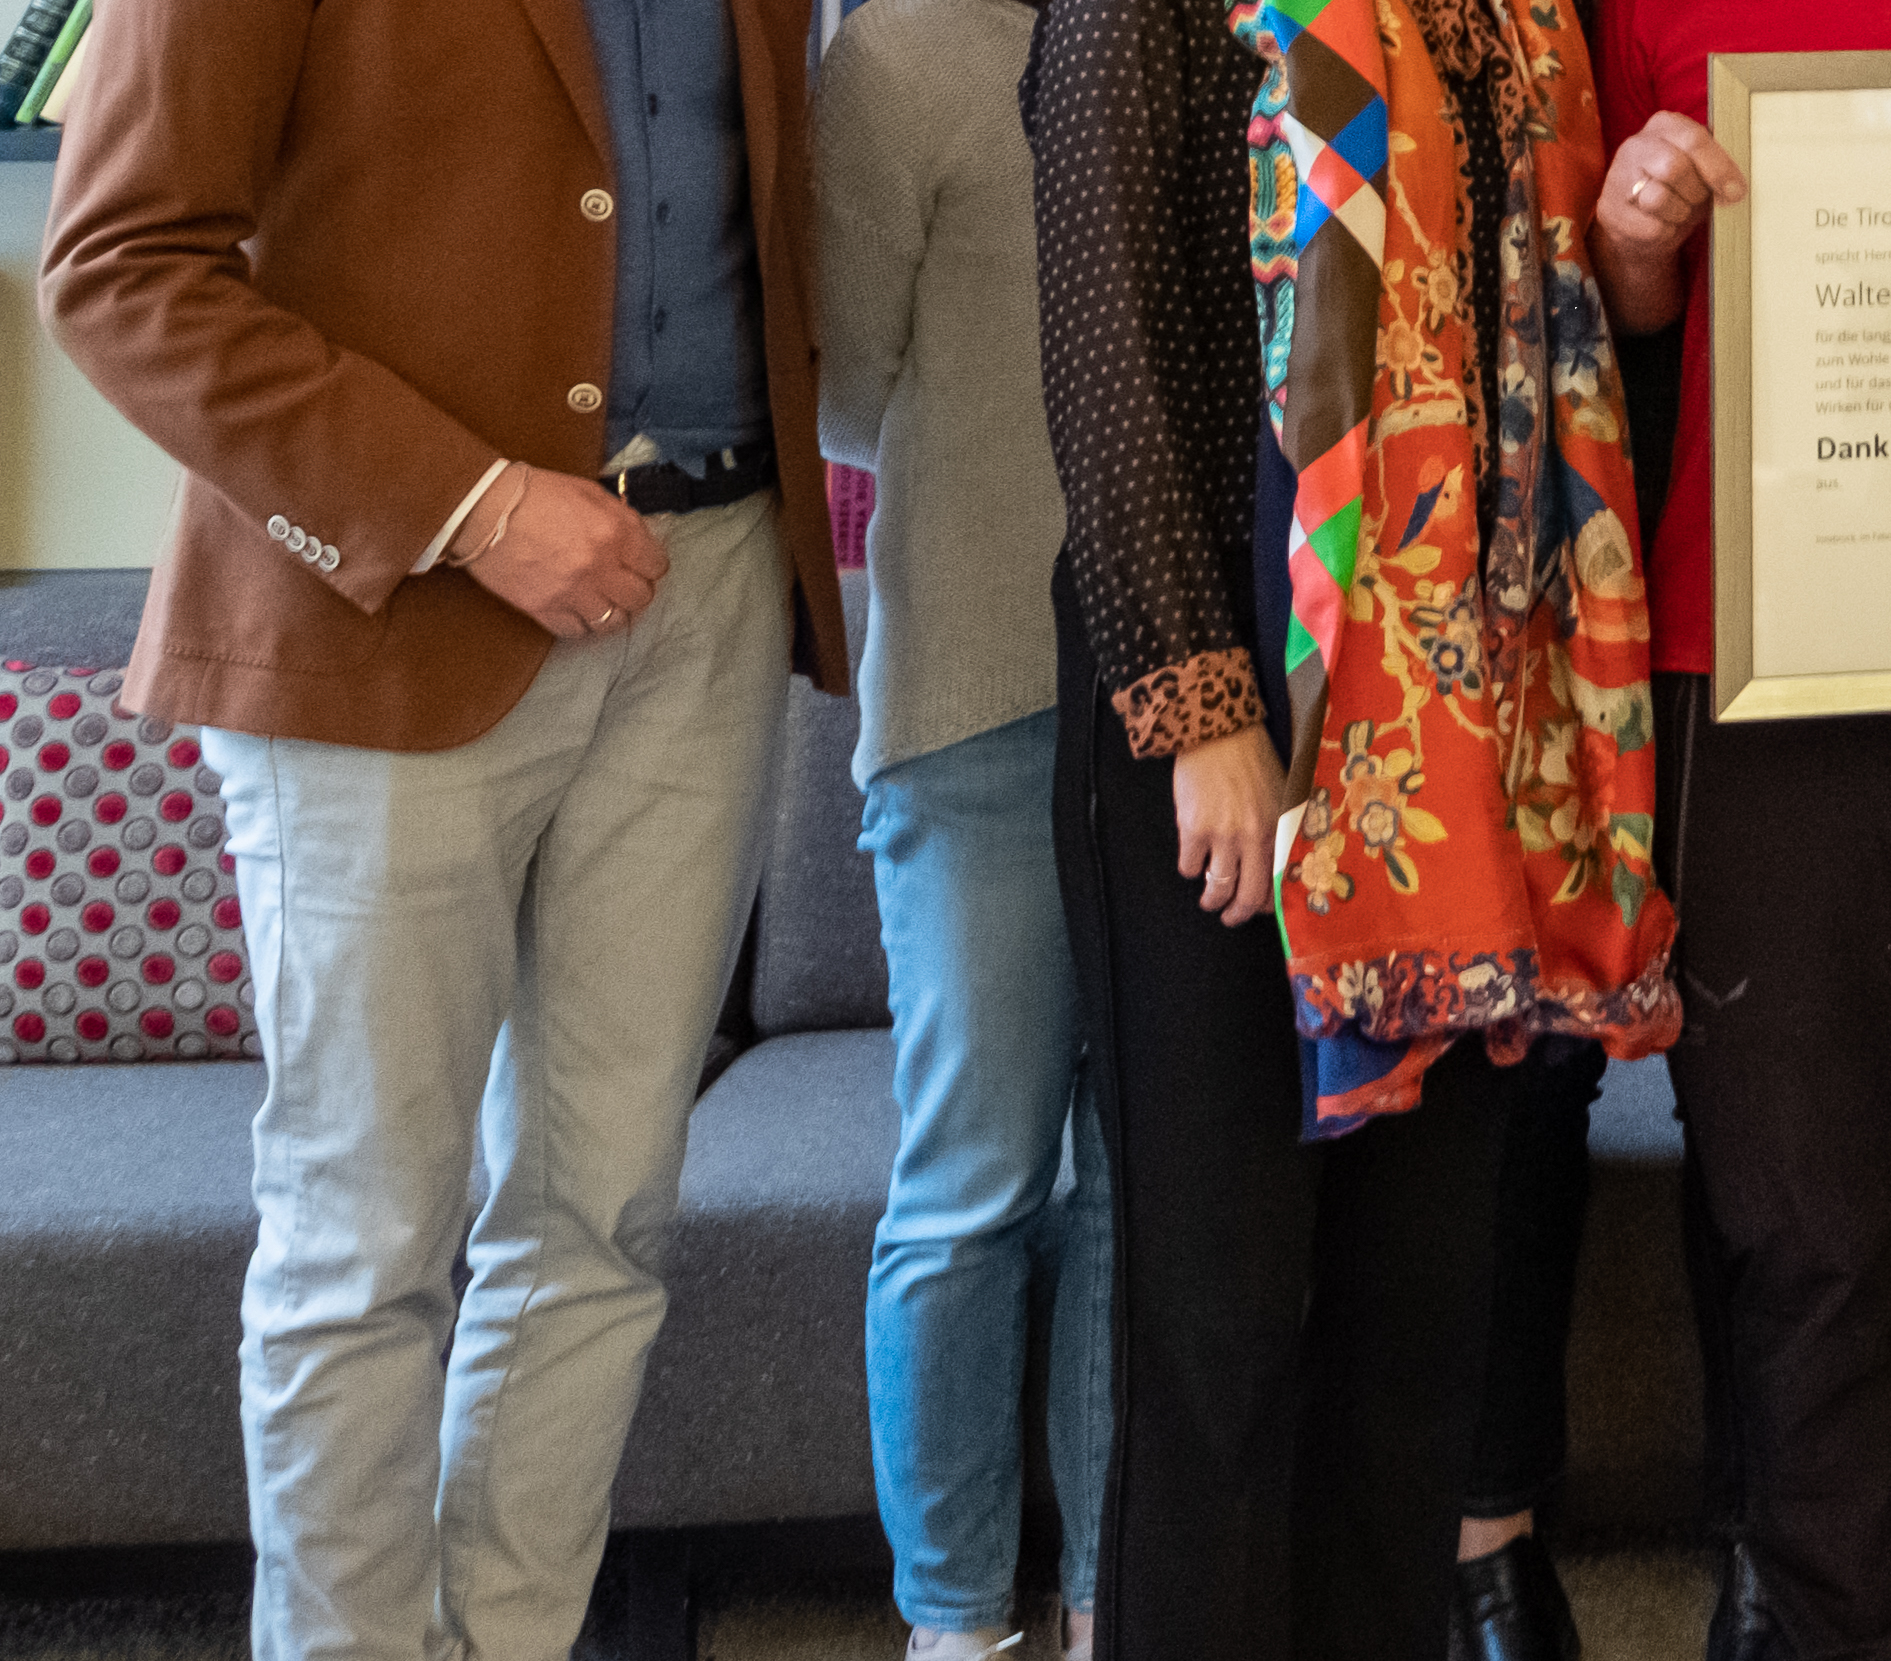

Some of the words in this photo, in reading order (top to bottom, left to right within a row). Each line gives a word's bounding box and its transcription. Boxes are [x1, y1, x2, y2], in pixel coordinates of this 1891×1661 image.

[1814, 207, 1848, 229] Die
[1815, 249, 1860, 264] spricht
[1816, 329, 1834, 343] für
[1838, 329, 1858, 342] die
[1816, 354, 1844, 367] zum
[1848, 352, 1890, 365] Wohle
[1816, 378, 1842, 391] und
[1846, 376, 1864, 389] für
[1868, 375, 1891, 389] das
[1816, 401, 1862, 414] Wirken
[1866, 399, 1884, 412] für
[1816, 433, 1889, 461] Dank
